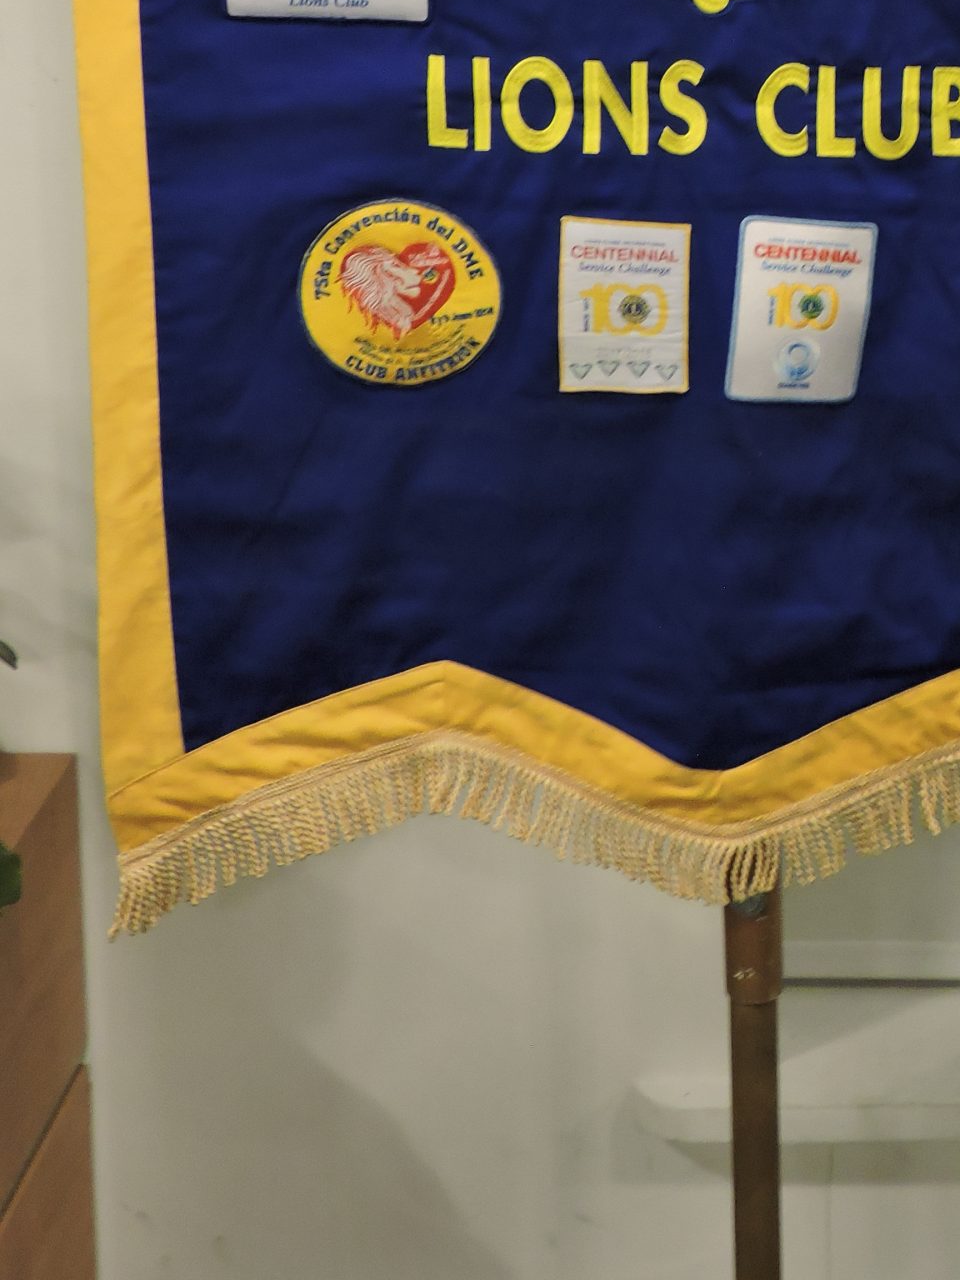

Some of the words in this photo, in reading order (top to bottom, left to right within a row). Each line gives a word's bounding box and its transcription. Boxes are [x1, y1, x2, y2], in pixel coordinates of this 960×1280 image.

[427, 53, 708, 156] LIONS
[324, 207, 421, 255] Convención
[426, 216, 455, 241] del
[451, 238, 484, 281] DME
[571, 245, 679, 263] CENTENNIAL
[754, 243, 863, 265] CENTENNIAL
[579, 262, 615, 273] Service
[618, 263, 672, 277] Challenge
[761, 260, 798, 273] Service
[800, 263, 855, 279] Challenge
[579, 282, 669, 336] 100
[767, 282, 840, 332] 100
[345, 355, 388, 379] CLUB
